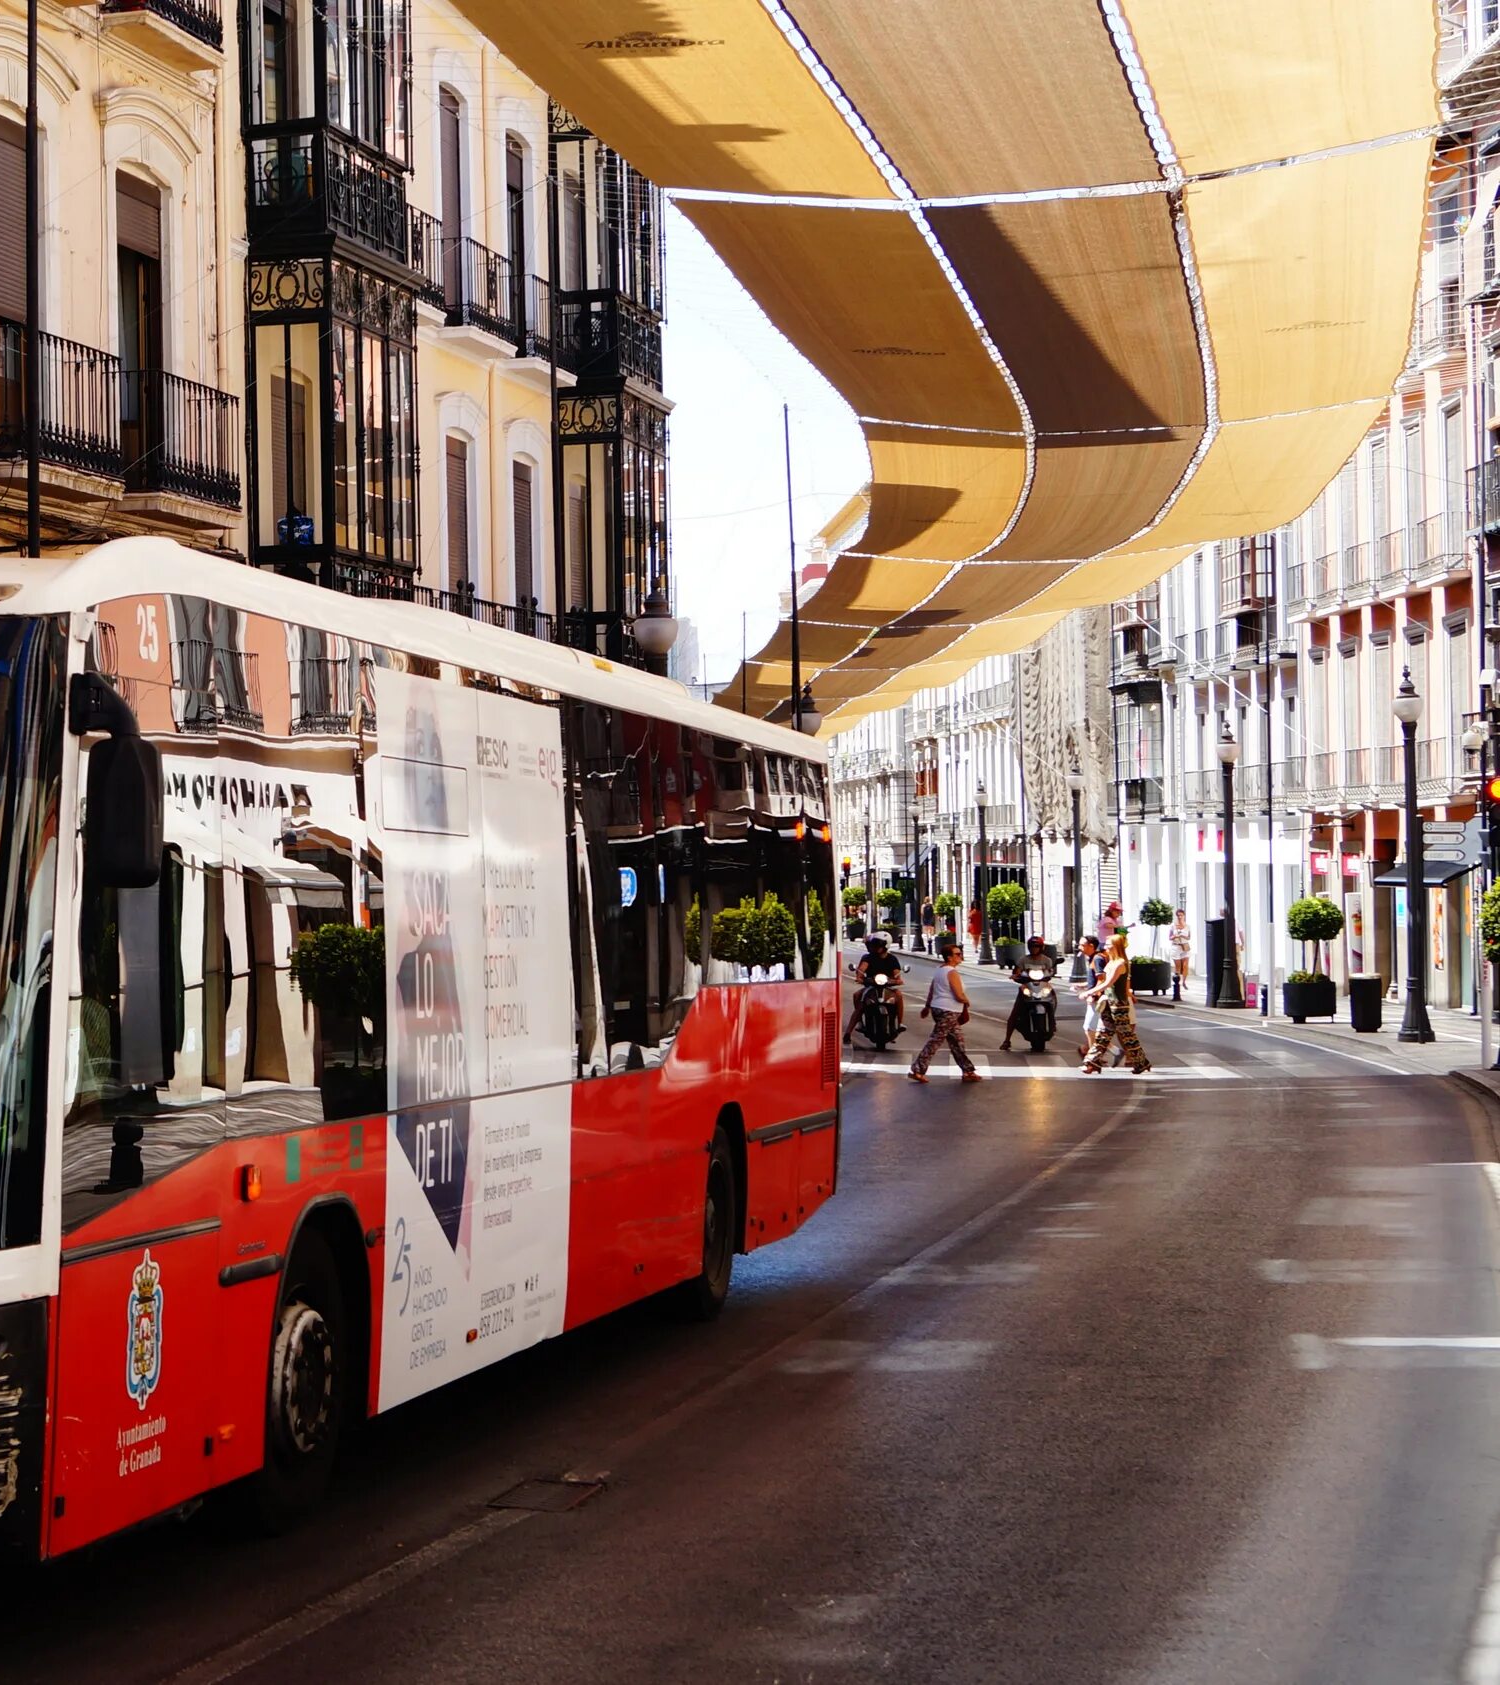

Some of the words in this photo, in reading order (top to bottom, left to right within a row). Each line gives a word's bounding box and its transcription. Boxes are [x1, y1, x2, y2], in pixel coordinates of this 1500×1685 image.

[577, 38, 725, 49] Alhambra
[136, 603, 159, 663] 25
[538, 747, 559, 799] eig
[412, 870, 452, 936] SACA
[415, 952, 434, 1019] LO
[483, 1001, 529, 1040] COMERCIAL
[416, 1032, 467, 1101] MEJOR
[415, 1123, 436, 1188] DE
[440, 1118, 453, 1184] TI
[116, 1413, 167, 1453] Ayuntamiento
[119, 1453, 129, 1477] de
[129, 1440, 162, 1473] Granada
